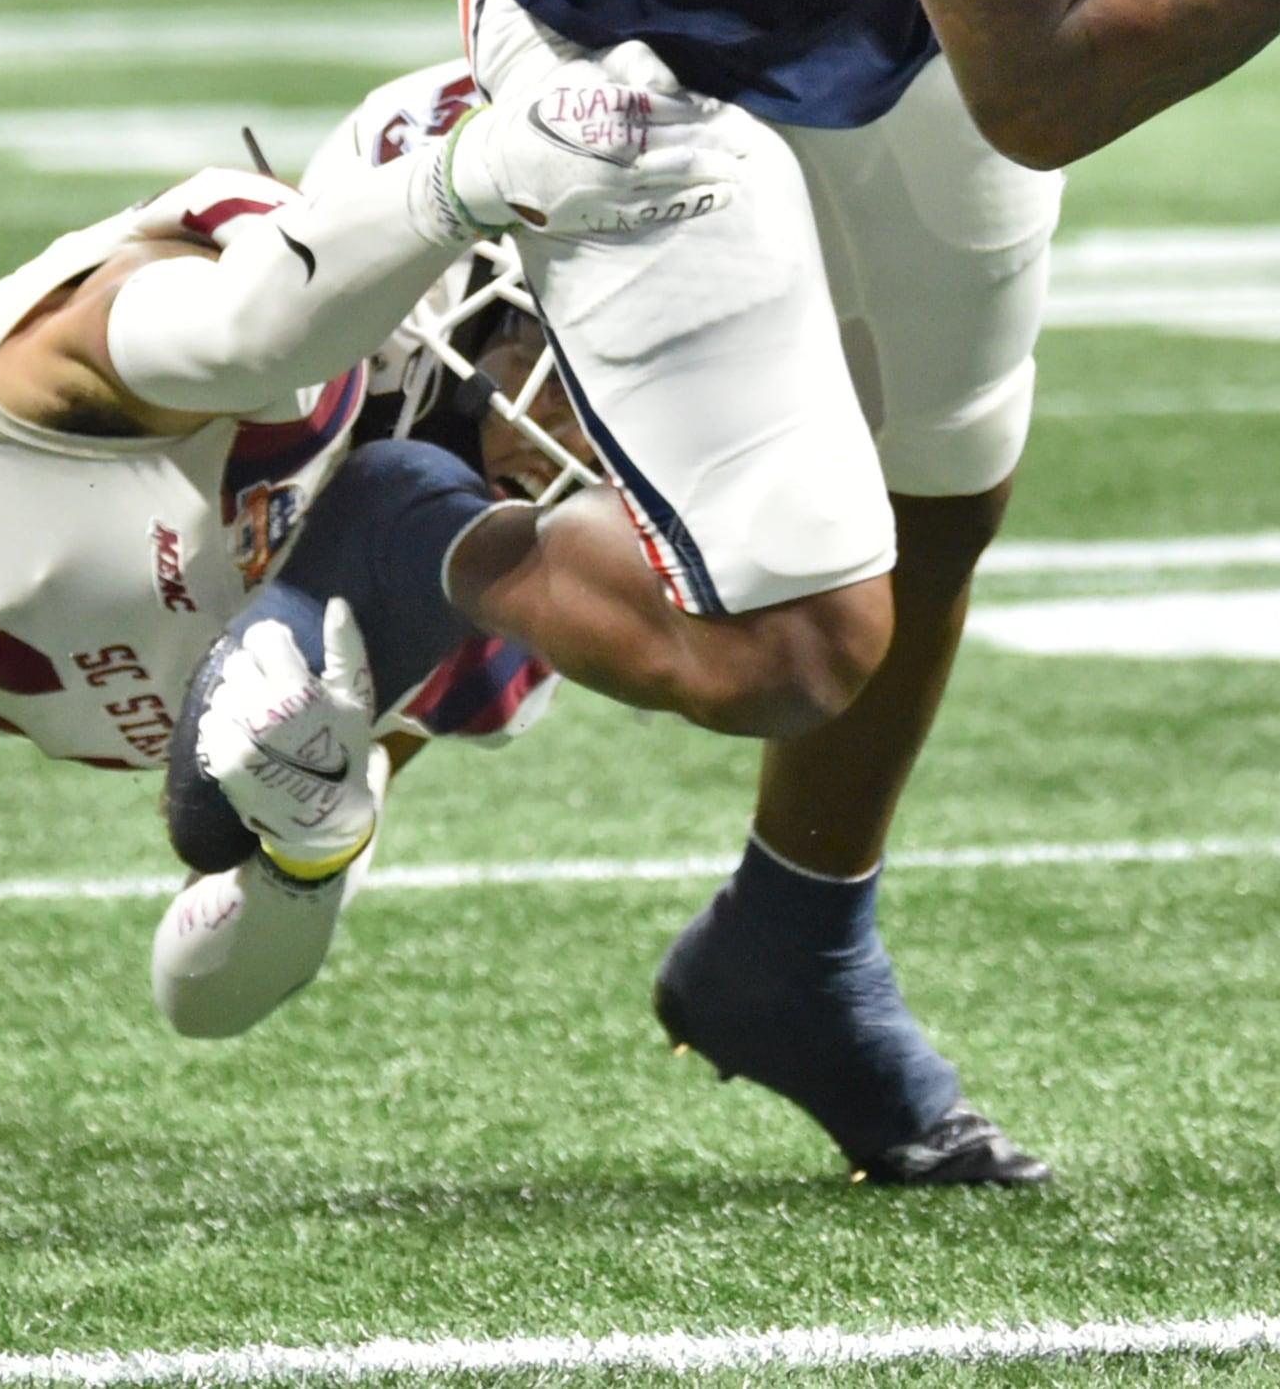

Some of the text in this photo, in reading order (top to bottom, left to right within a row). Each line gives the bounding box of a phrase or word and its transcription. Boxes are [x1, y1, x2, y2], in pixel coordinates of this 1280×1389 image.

[151, 523, 197, 612] MEAC
[73, 644, 174, 760] SC STA
